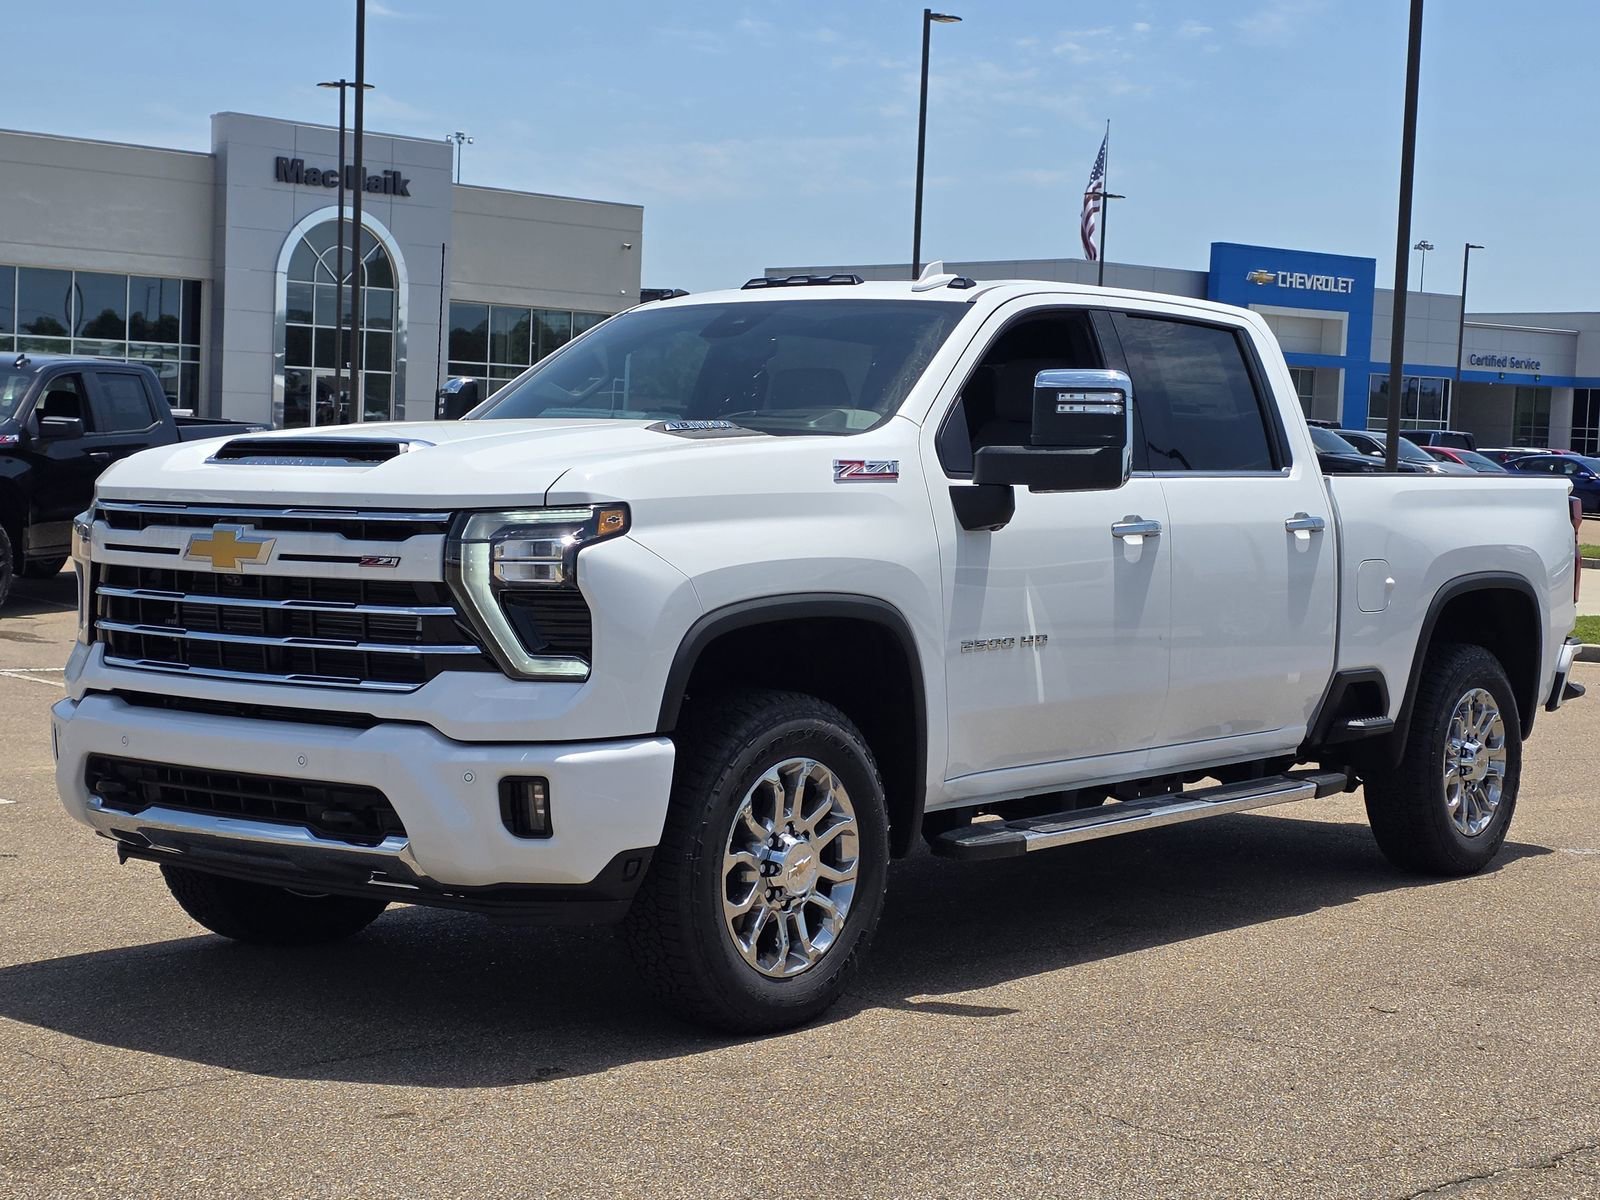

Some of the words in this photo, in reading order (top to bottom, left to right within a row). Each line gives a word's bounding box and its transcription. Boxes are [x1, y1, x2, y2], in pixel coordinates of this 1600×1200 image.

[275, 155, 339, 188] Mac
[1277, 271, 1355, 294] CHEVROLET
[1469, 353, 1508, 368] Certified
[1510, 356, 1541, 370] Service
[833, 459, 899, 483] Z71
[359, 555, 401, 568] Z71
[960, 637, 1015, 653] 2500
[1020, 634, 1048, 649] HD
